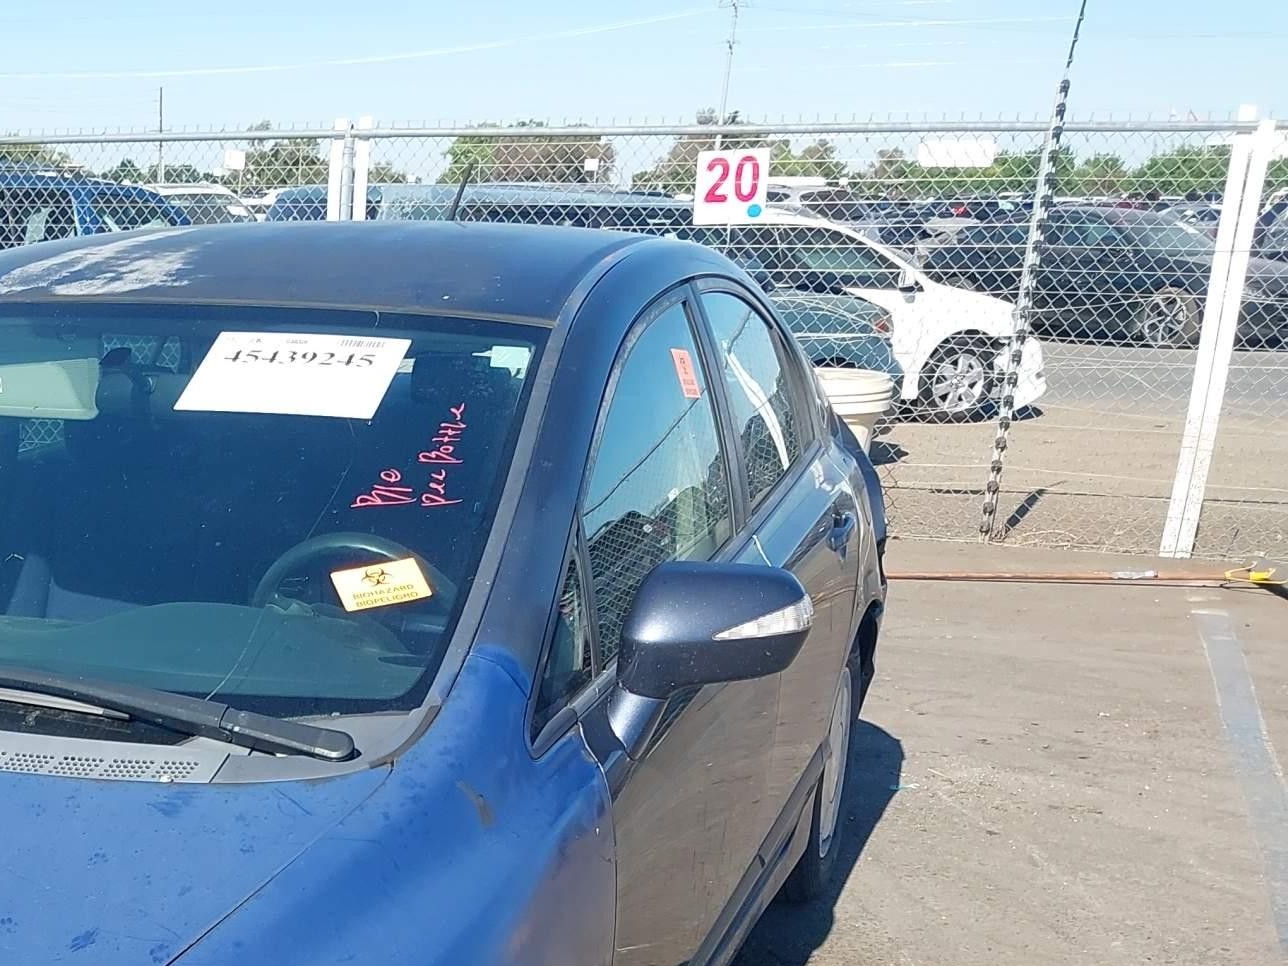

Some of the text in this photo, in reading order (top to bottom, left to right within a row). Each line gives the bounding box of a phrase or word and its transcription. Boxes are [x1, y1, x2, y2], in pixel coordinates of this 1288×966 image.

[704, 155, 760, 203] 20
[224, 348, 377, 368] 45439245
[352, 583, 414, 600] BIOHAZARD
